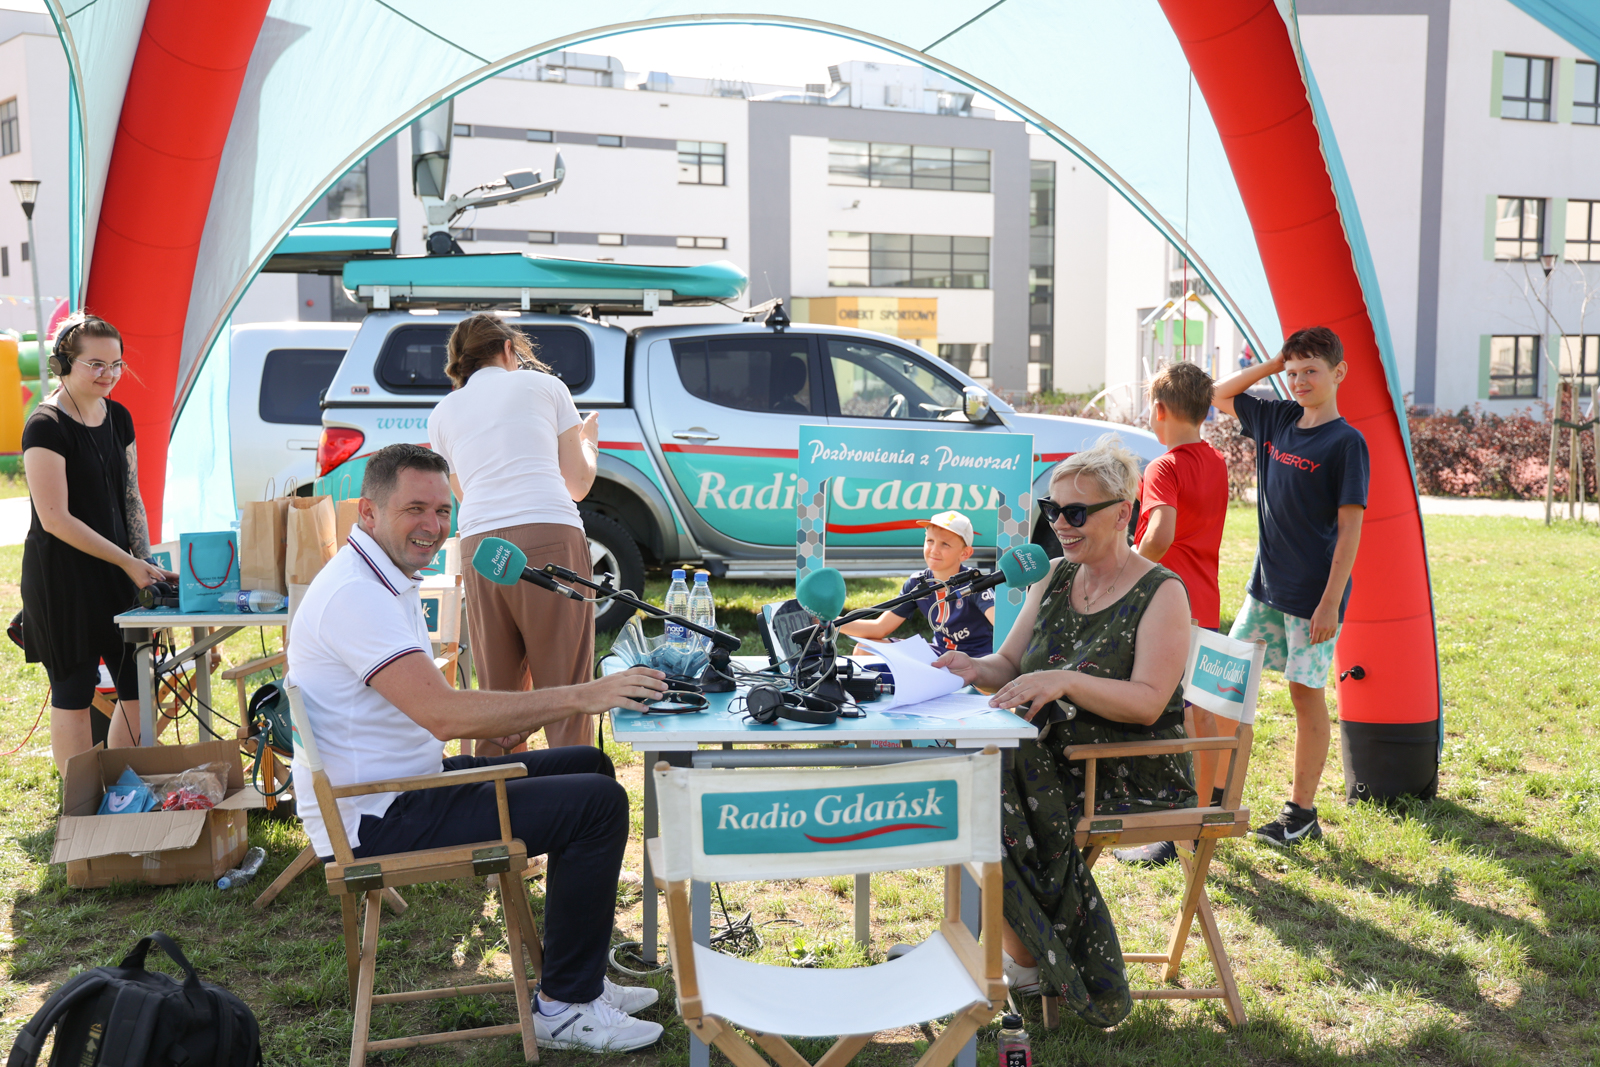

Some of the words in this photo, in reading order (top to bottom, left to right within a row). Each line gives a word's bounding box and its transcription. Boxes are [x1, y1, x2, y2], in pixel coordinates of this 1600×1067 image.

[839, 309, 875, 320] OBIEKT
[880, 309, 937, 320] SPORTOWY
[808, 439, 915, 465] Pozdrowienia
[920, 456, 930, 466] z
[935, 445, 1021, 471] Pomorza!
[1272, 449, 1321, 473] MERCY
[694, 471, 799, 510] Radi
[491, 545, 504, 565] Radio
[493, 548, 512, 576] Gdańsk
[1014, 549, 1032, 572] Gdańsk
[1025, 552, 1037, 570] Radio
[1199, 654, 1223, 677] Radio
[1222, 660, 1246, 684] Gdańsk
[717, 802, 807, 830] Radio
[814, 787, 945, 826] Gdańsk
